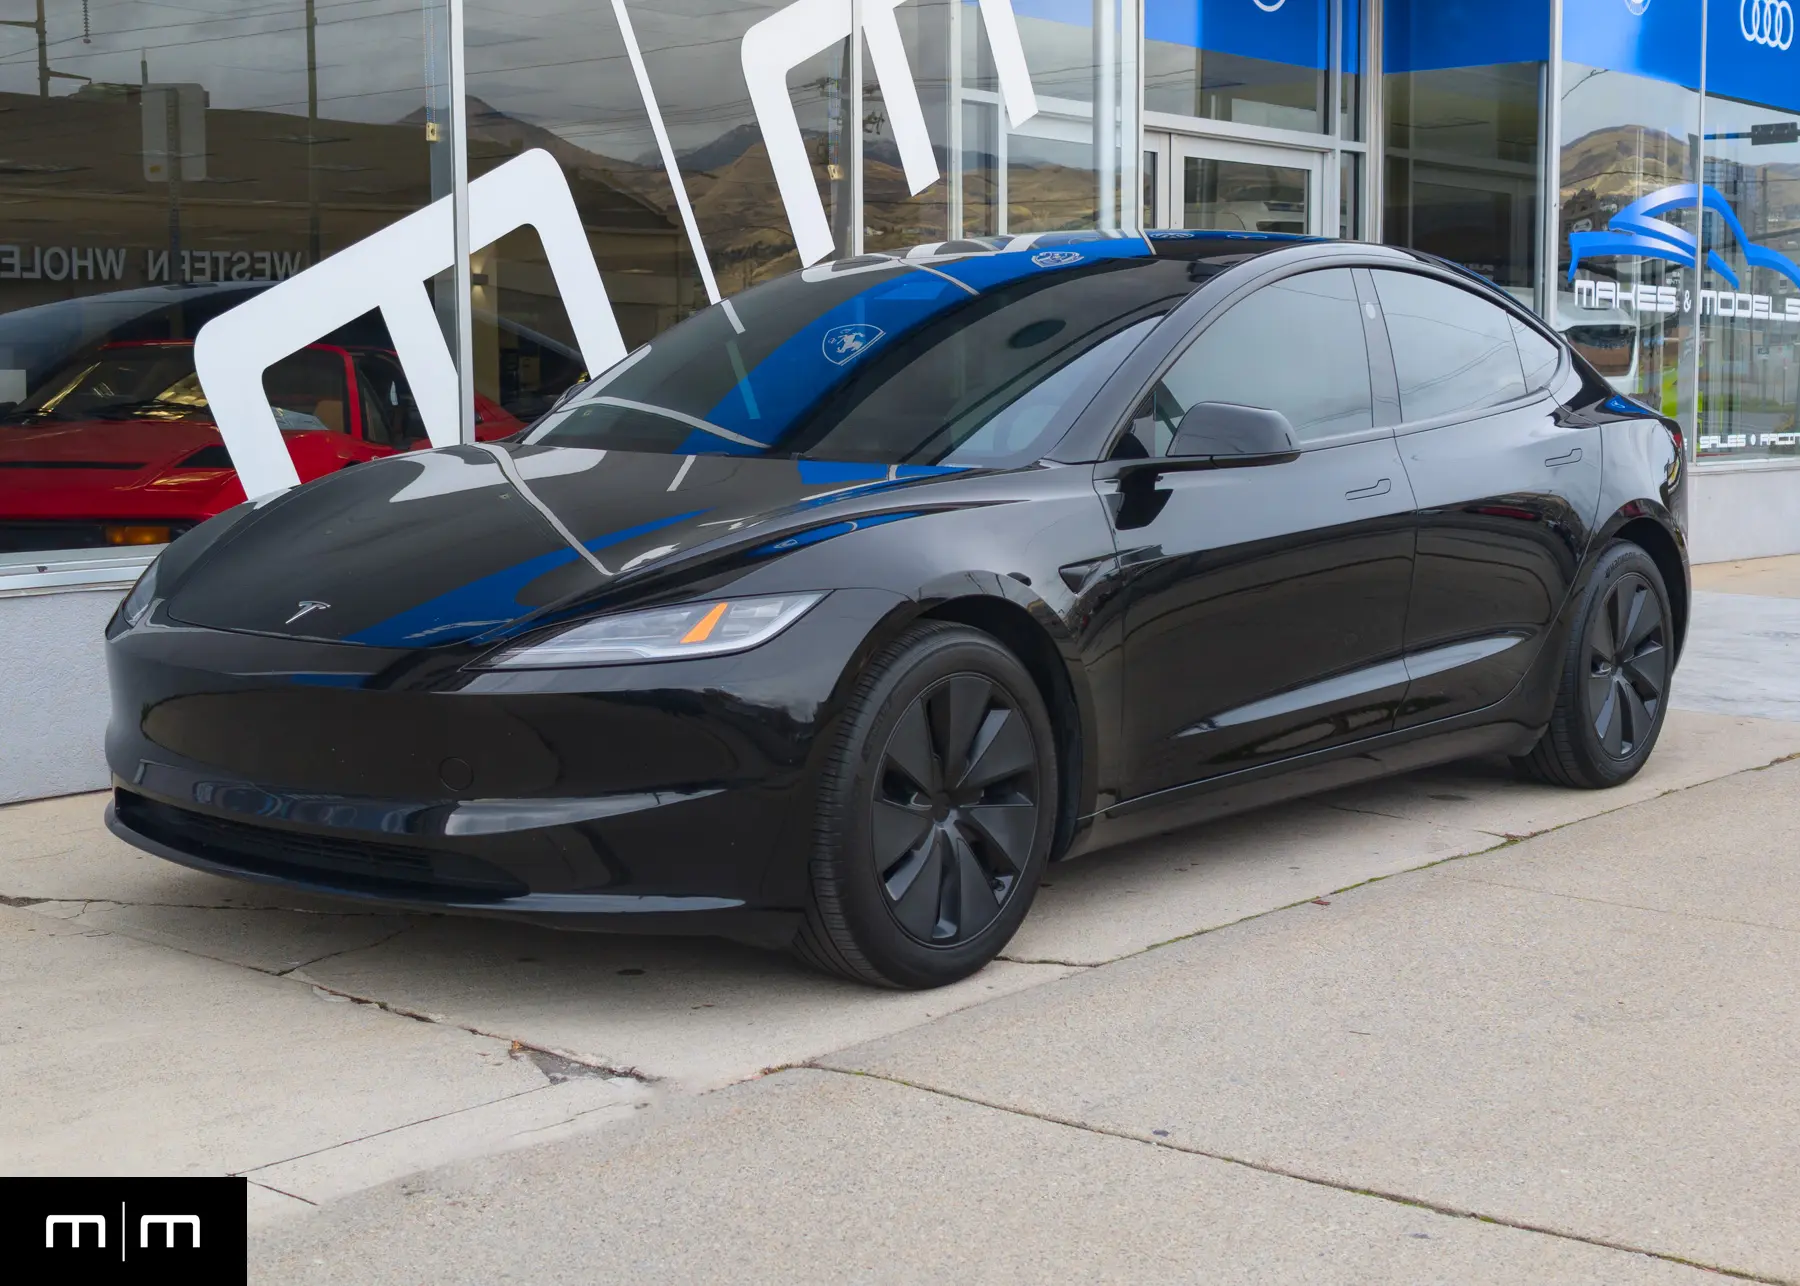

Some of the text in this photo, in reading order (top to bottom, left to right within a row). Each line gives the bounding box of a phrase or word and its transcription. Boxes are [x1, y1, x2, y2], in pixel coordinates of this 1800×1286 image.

[1575, 280, 1800, 321] MAKES & MODELS
[1700, 434, 1746, 448] SALES
